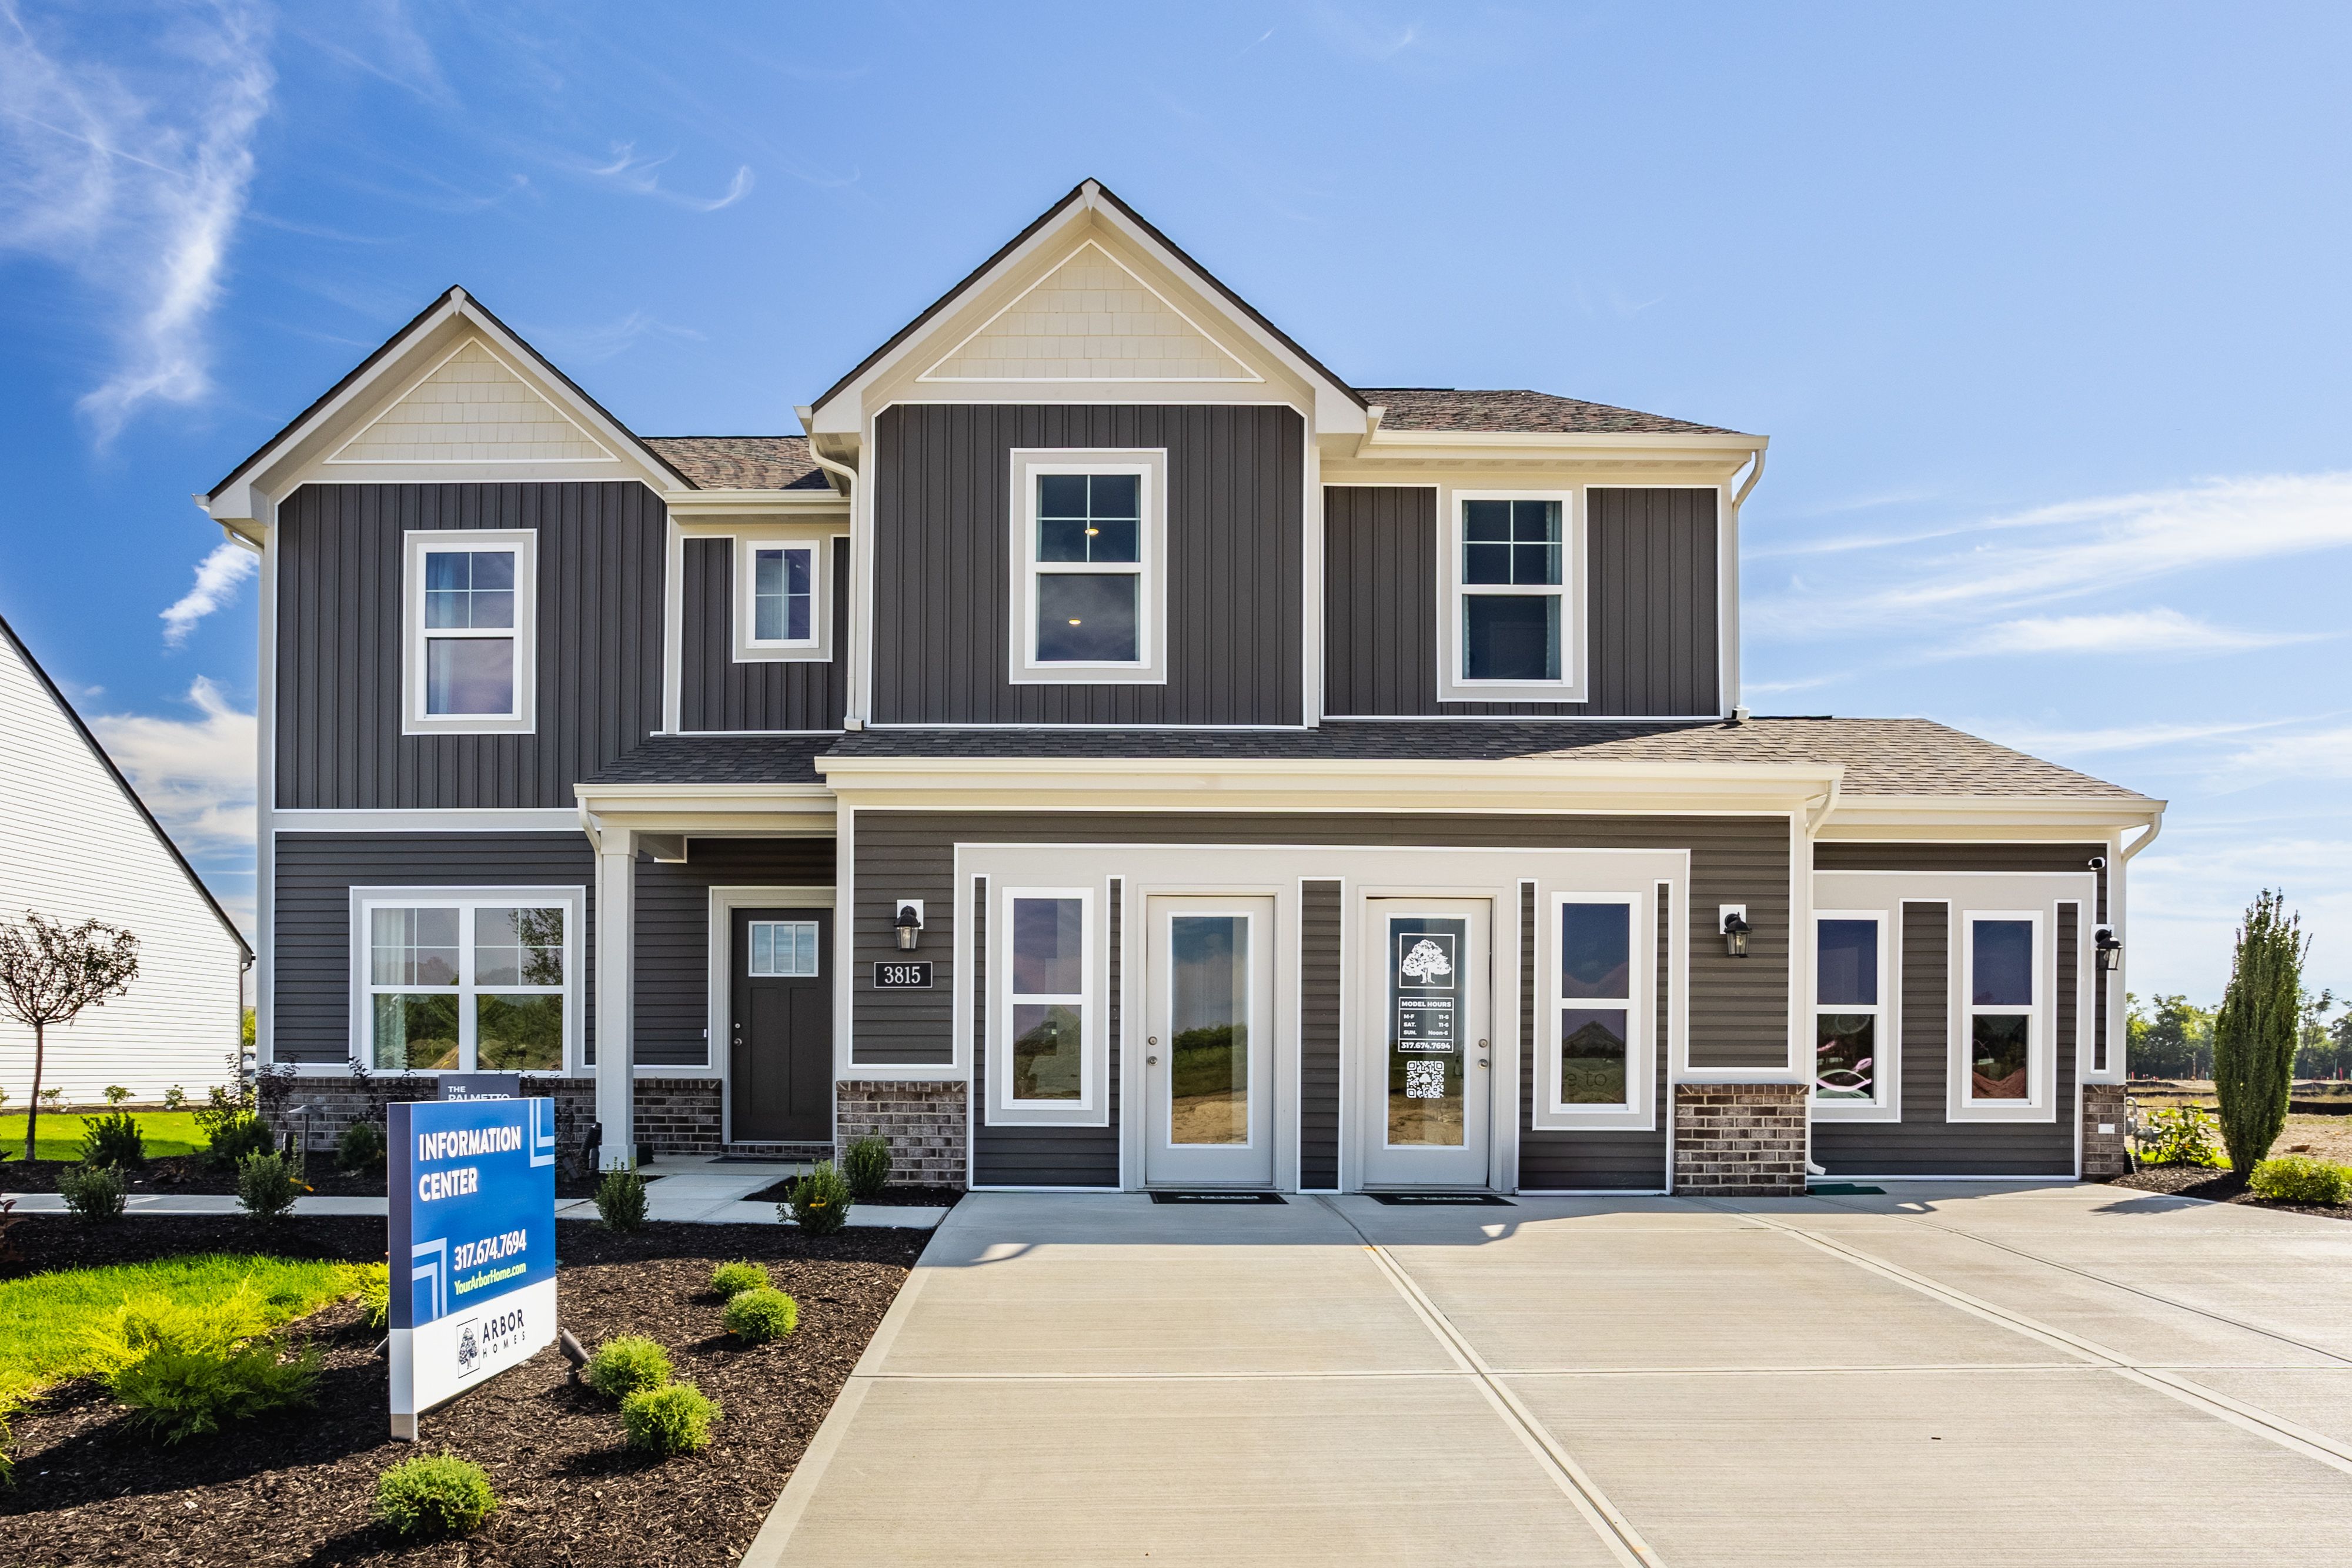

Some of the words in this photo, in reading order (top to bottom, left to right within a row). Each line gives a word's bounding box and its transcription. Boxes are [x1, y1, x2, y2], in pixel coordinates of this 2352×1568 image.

[884, 966, 921, 984] 3815
[1585, 1071, 1607, 1087] to
[419, 1126, 521, 1161] INFORMATION
[419, 1167, 477, 1202] CENTER
[454, 1229, 527, 1271] 317.674.7694
[454, 1263, 526, 1295] YourArborHome.com
[483, 1309, 524, 1343] ARBOR
[483, 1331, 525, 1358] HOMES
